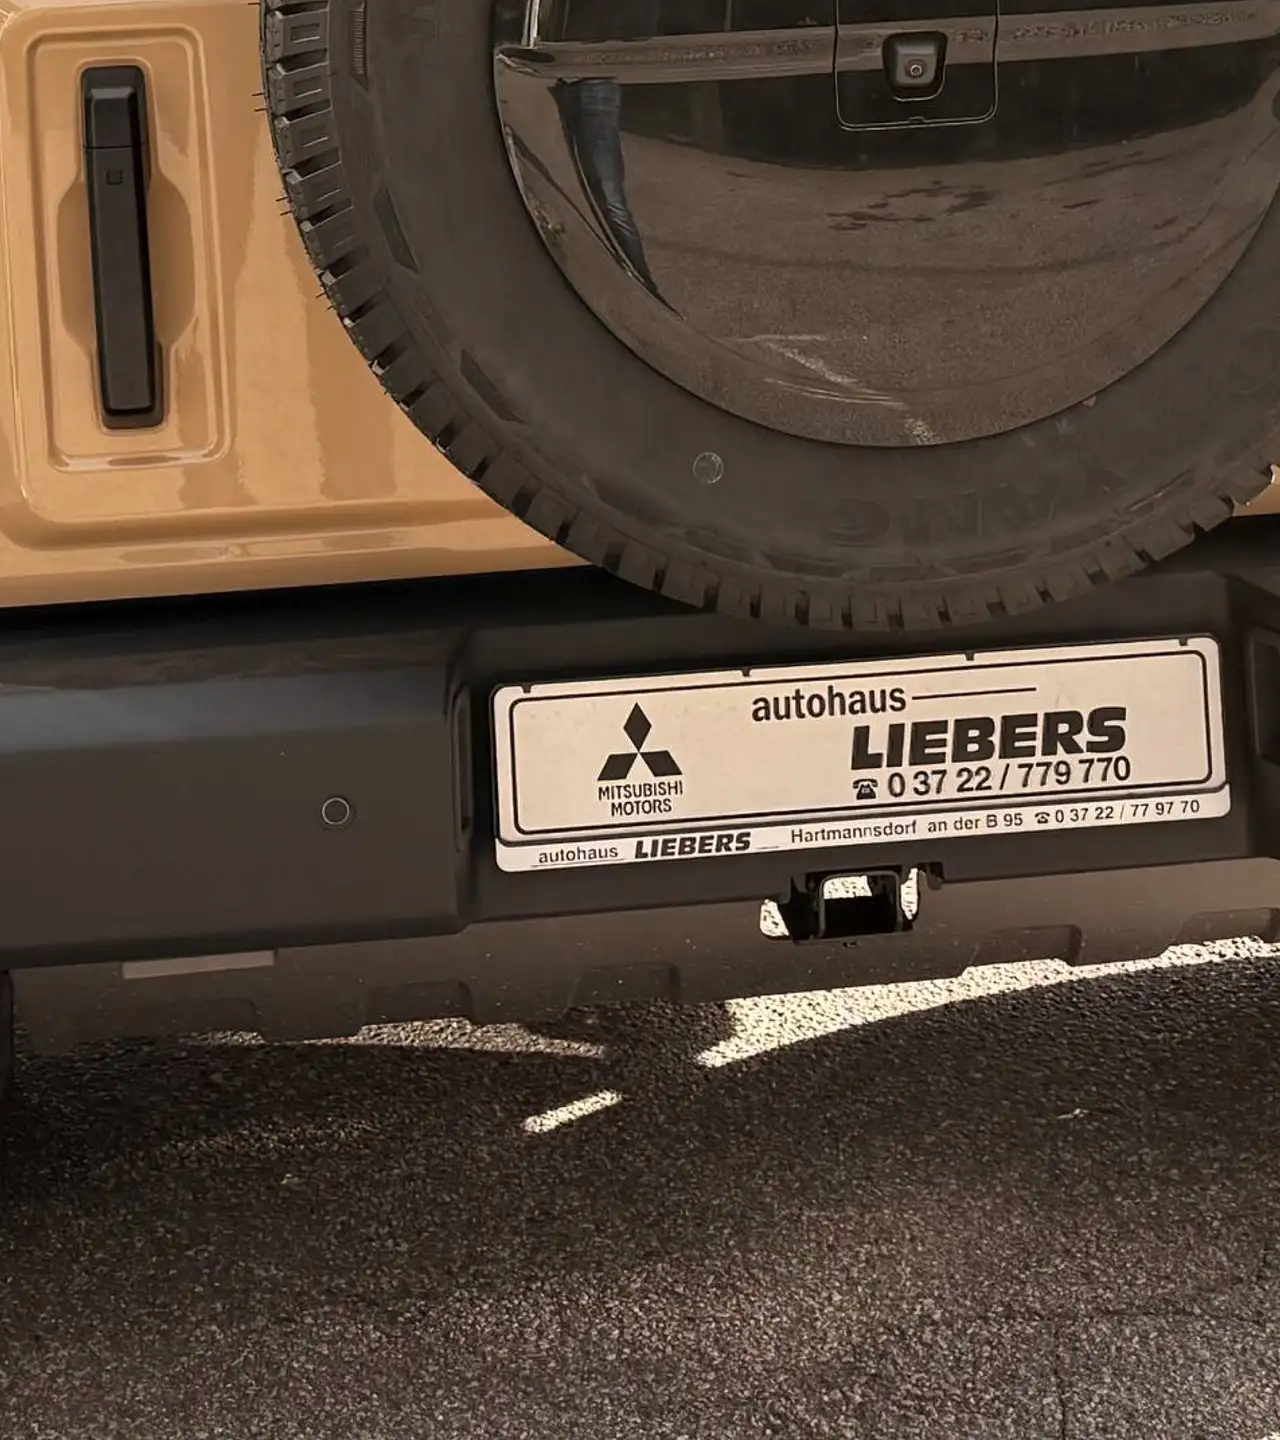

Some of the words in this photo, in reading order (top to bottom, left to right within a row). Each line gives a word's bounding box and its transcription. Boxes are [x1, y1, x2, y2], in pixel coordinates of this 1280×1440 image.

[752, 685, 906, 721] autohaus
[851, 707, 1126, 770] LIEBERS
[598, 780, 683, 801] MITSUBISHI
[888, 772, 905, 797] 0
[913, 769, 947, 795] 37
[956, 767, 992, 792] 22
[999, 763, 1010, 790] /
[1018, 760, 1071, 788] 779
[1079, 756, 1131, 783] 770
[611, 799, 672, 817] MOTORS
[538, 844, 618, 864] autohaus
[635, 832, 751, 860] LIEBERS
[791, 819, 916, 843] Hartmannsdorf
[928, 820, 947, 832] an
[954, 815, 980, 830] der
[986, 815, 997, 828] B
[1003, 813, 1023, 827] 95
[1055, 809, 1065, 823] 0
[1070, 808, 1089, 822] 37
[1095, 806, 1114, 820] 22
[1131, 803, 1148, 817] 77
[1155, 801, 1174, 816] 97
[1180, 799, 1200, 813] 70
